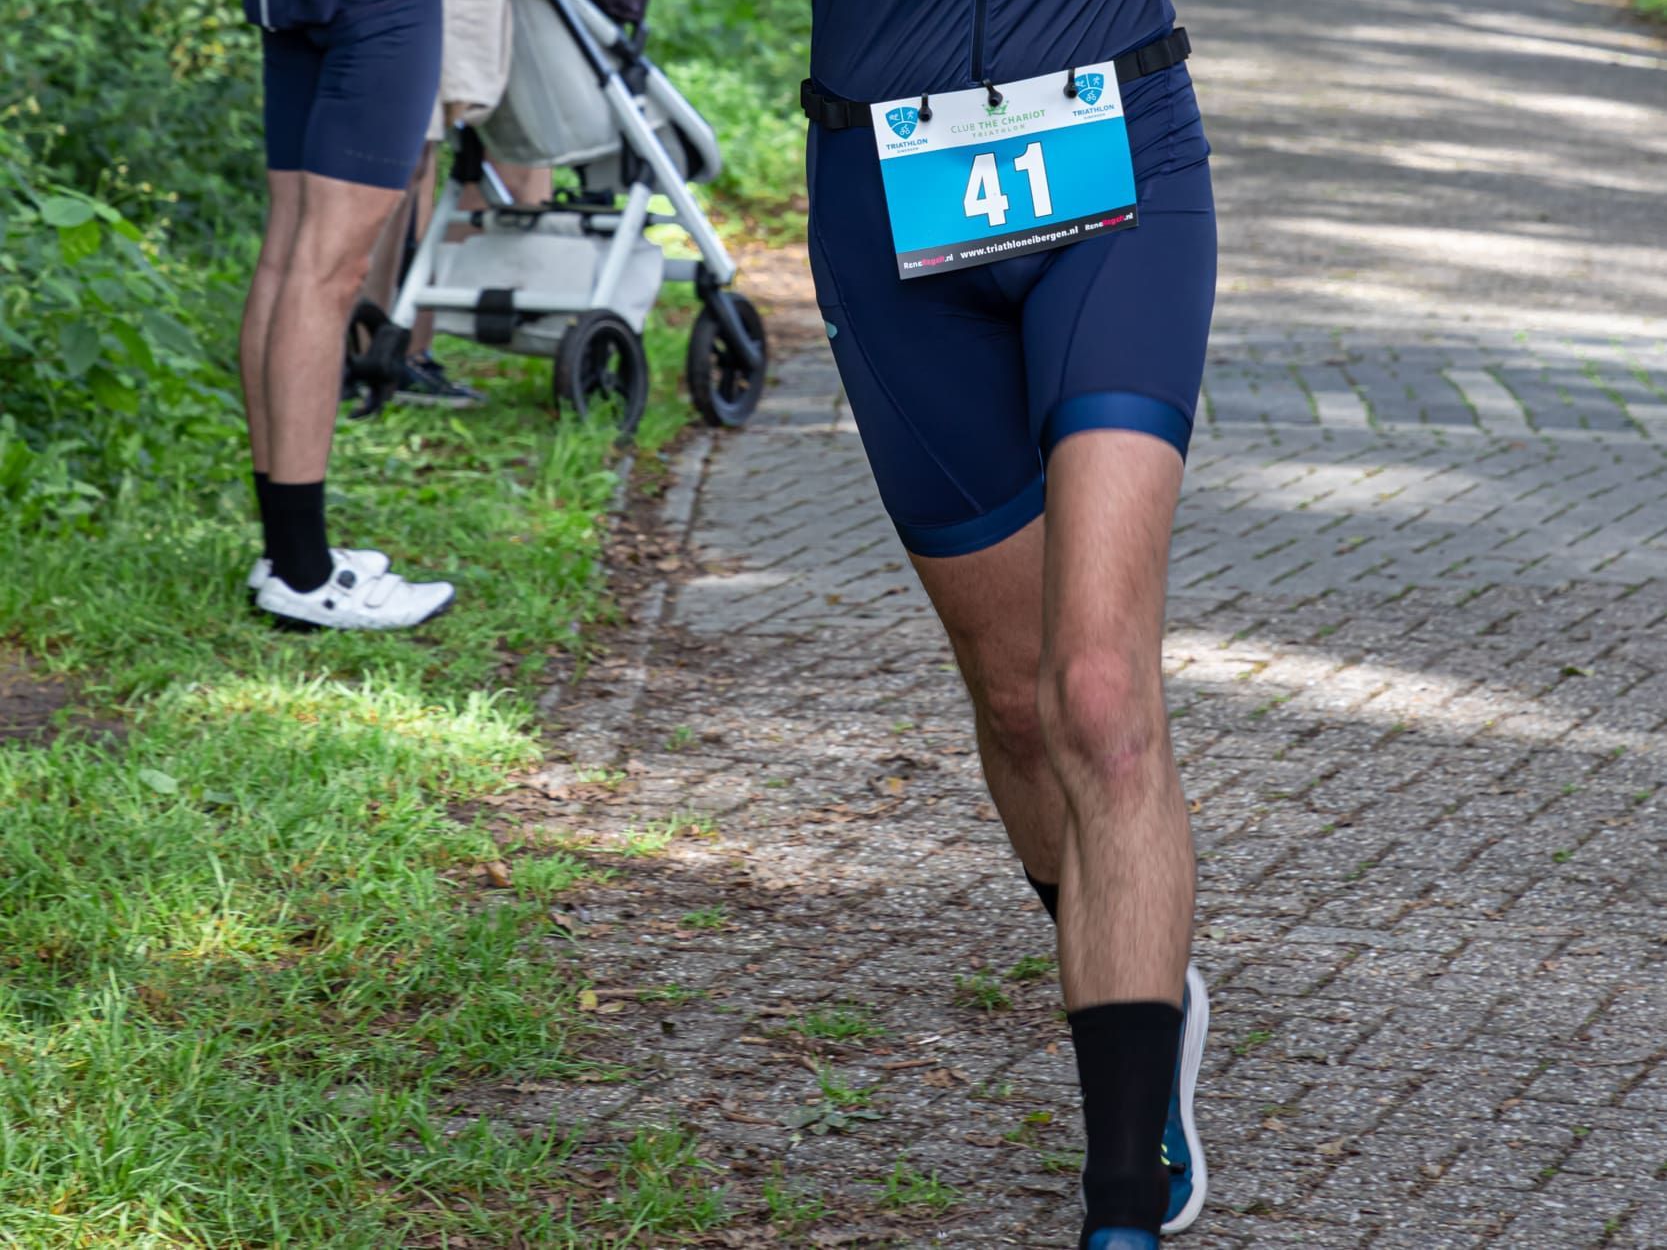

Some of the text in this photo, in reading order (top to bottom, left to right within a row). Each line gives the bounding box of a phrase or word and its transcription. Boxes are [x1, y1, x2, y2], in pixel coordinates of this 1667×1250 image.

[950, 109, 1046, 134] CLUB THE CHARIOT
[1072, 104, 1115, 117] TRIATHLON
[885, 138, 929, 151] TRIATHLON
[963, 141, 1053, 227] 41
[960, 225, 1079, 259] www.triathloneibergen.nl
